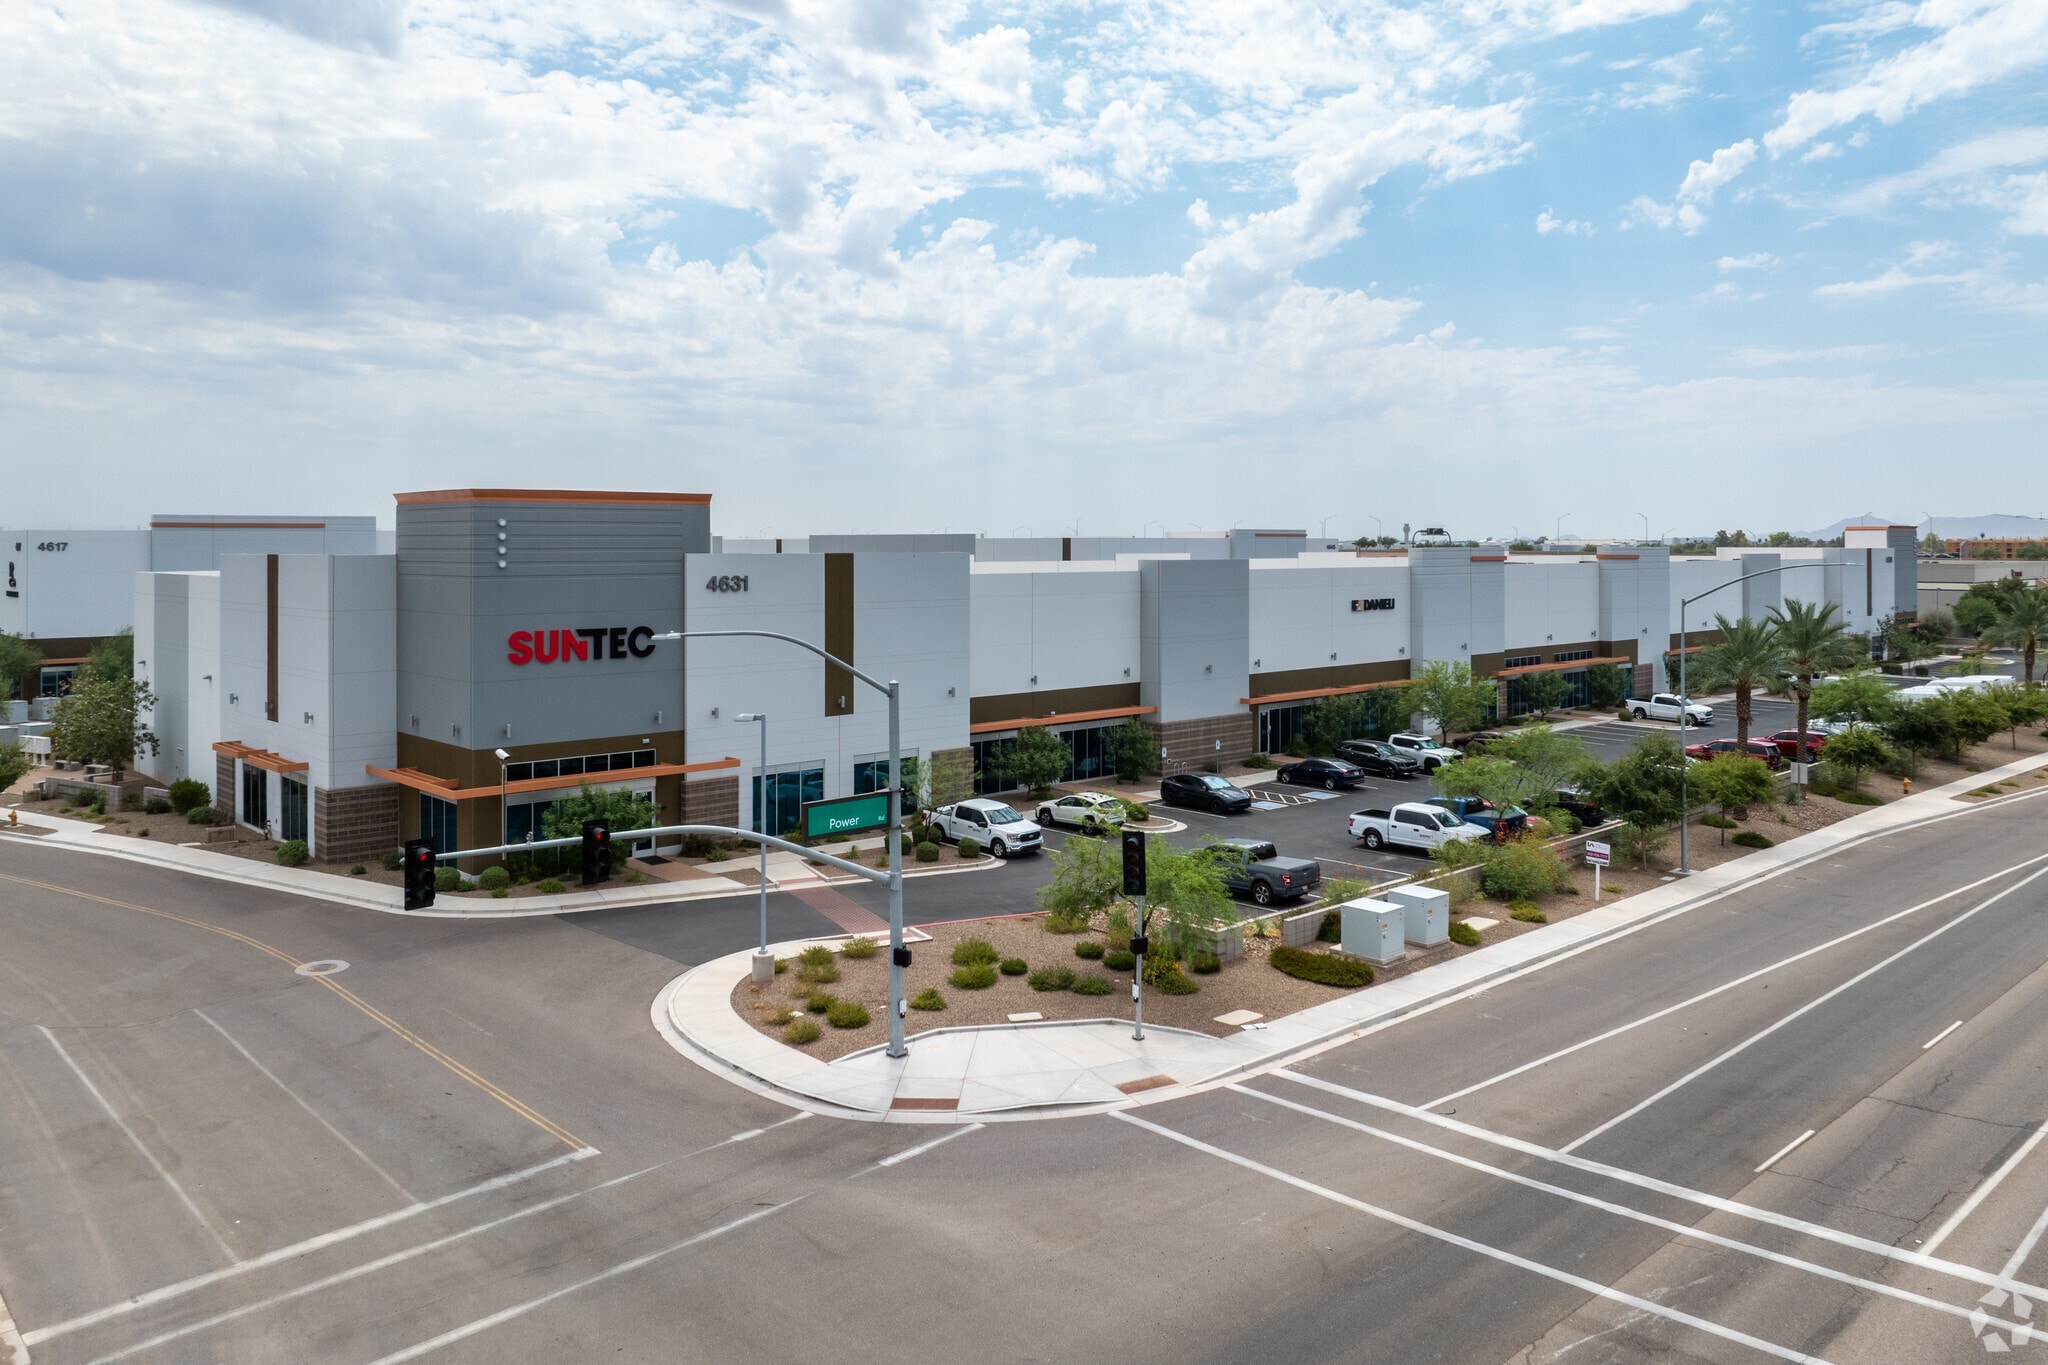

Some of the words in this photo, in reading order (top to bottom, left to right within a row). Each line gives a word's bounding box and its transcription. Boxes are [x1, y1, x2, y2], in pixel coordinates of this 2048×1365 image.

[37, 541, 69, 552] 4617
[706, 575, 749, 592] 4631
[508, 626, 657, 665] SUNTEC
[829, 816, 860, 830] Power
